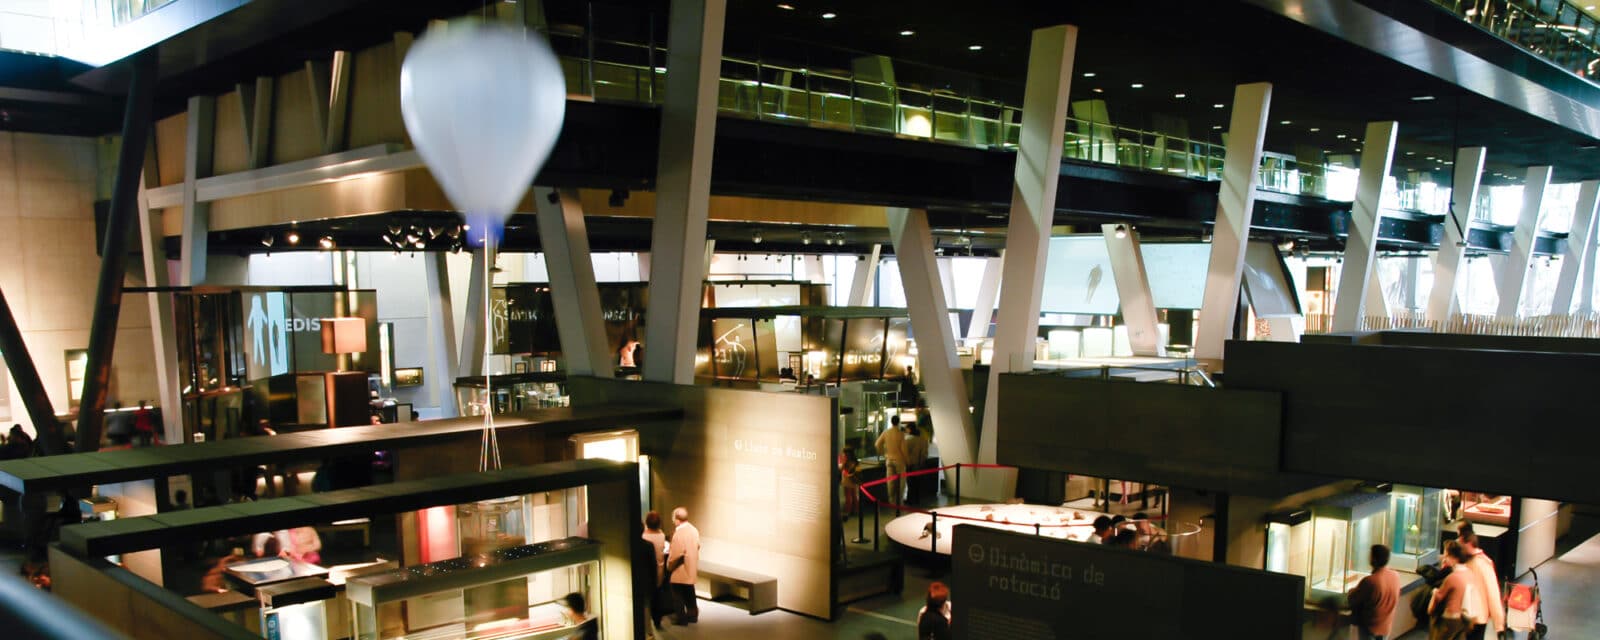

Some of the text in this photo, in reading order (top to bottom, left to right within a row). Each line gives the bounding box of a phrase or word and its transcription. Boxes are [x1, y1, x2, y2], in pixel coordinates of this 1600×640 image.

[989, 545, 1105, 584] Dinàmica de
[988, 573, 1061, 600] rotació
